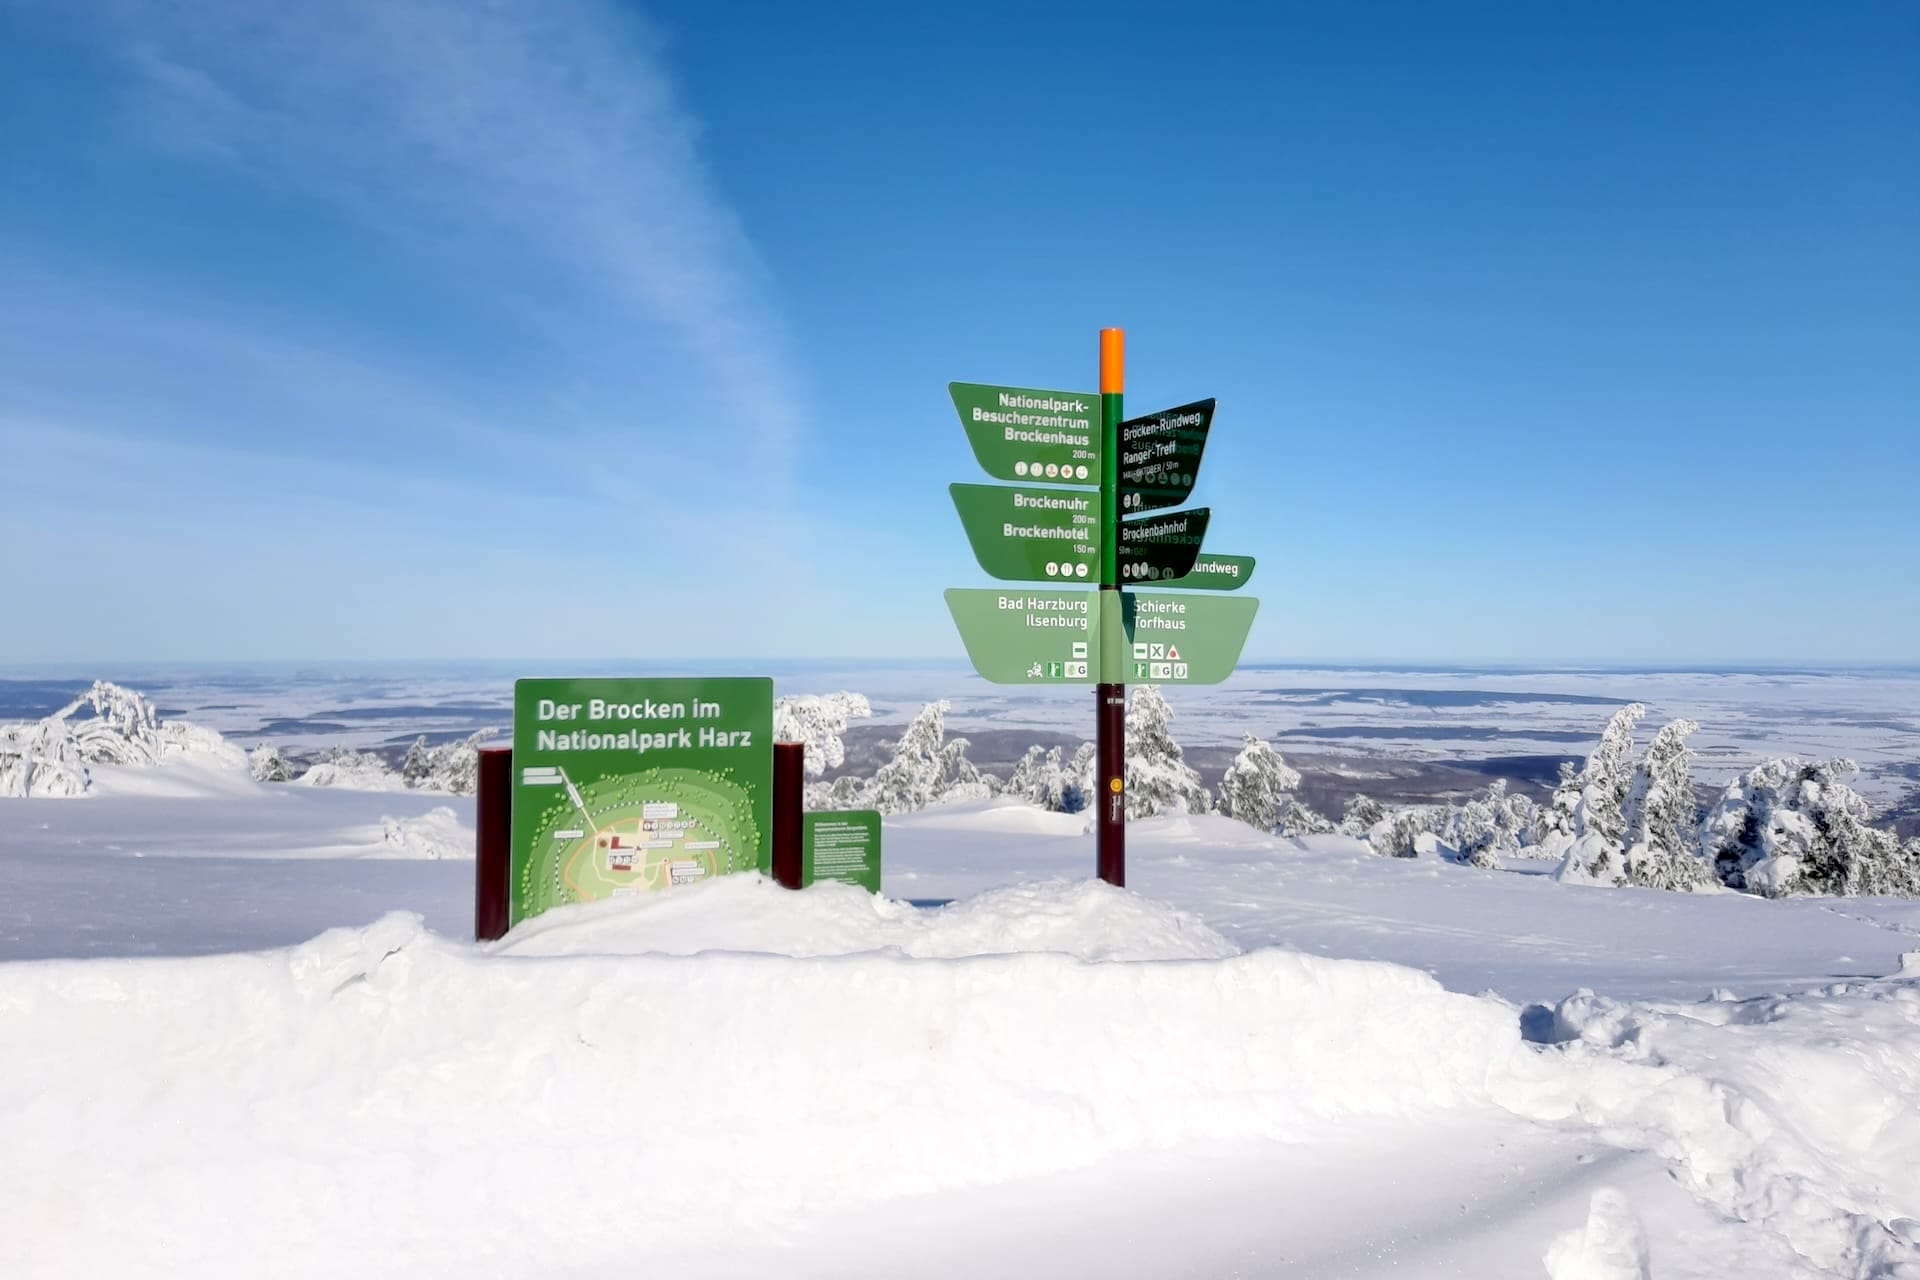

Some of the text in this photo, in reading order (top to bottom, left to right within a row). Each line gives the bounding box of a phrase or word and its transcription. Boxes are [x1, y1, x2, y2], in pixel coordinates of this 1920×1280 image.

[998, 392, 1089, 413] Nationalpark-
[972, 407, 1089, 429] Besucherzentrum
[1123, 412, 1200, 441] Brocken-Rundweg
[1004, 427, 1089, 446] Brockenhaus
[1072, 449, 1096, 460] 200 m
[1123, 440, 1176, 465] Ranger-Treff
[1013, 493, 1089, 511] Brockenuhr
[1072, 514, 1087, 524] 200
[1003, 523, 1089, 540] Brockenhotel
[1122, 518, 1188, 541] Brockenbahnhof
[1073, 544, 1087, 554] 150
[1191, 561, 1239, 577] undweg
[998, 596, 1088, 614] Bad Harzburg
[1133, 600, 1186, 614] Schierke
[1026, 614, 1088, 630] Ilsenburg
[1133, 615, 1186, 630] Torfhaus
[1078, 665, 1086, 675] G
[1162, 667, 1170, 676] G
[538, 698, 720, 721] Der Brocken im
[537, 727, 752, 754] Nationalpark Harz
